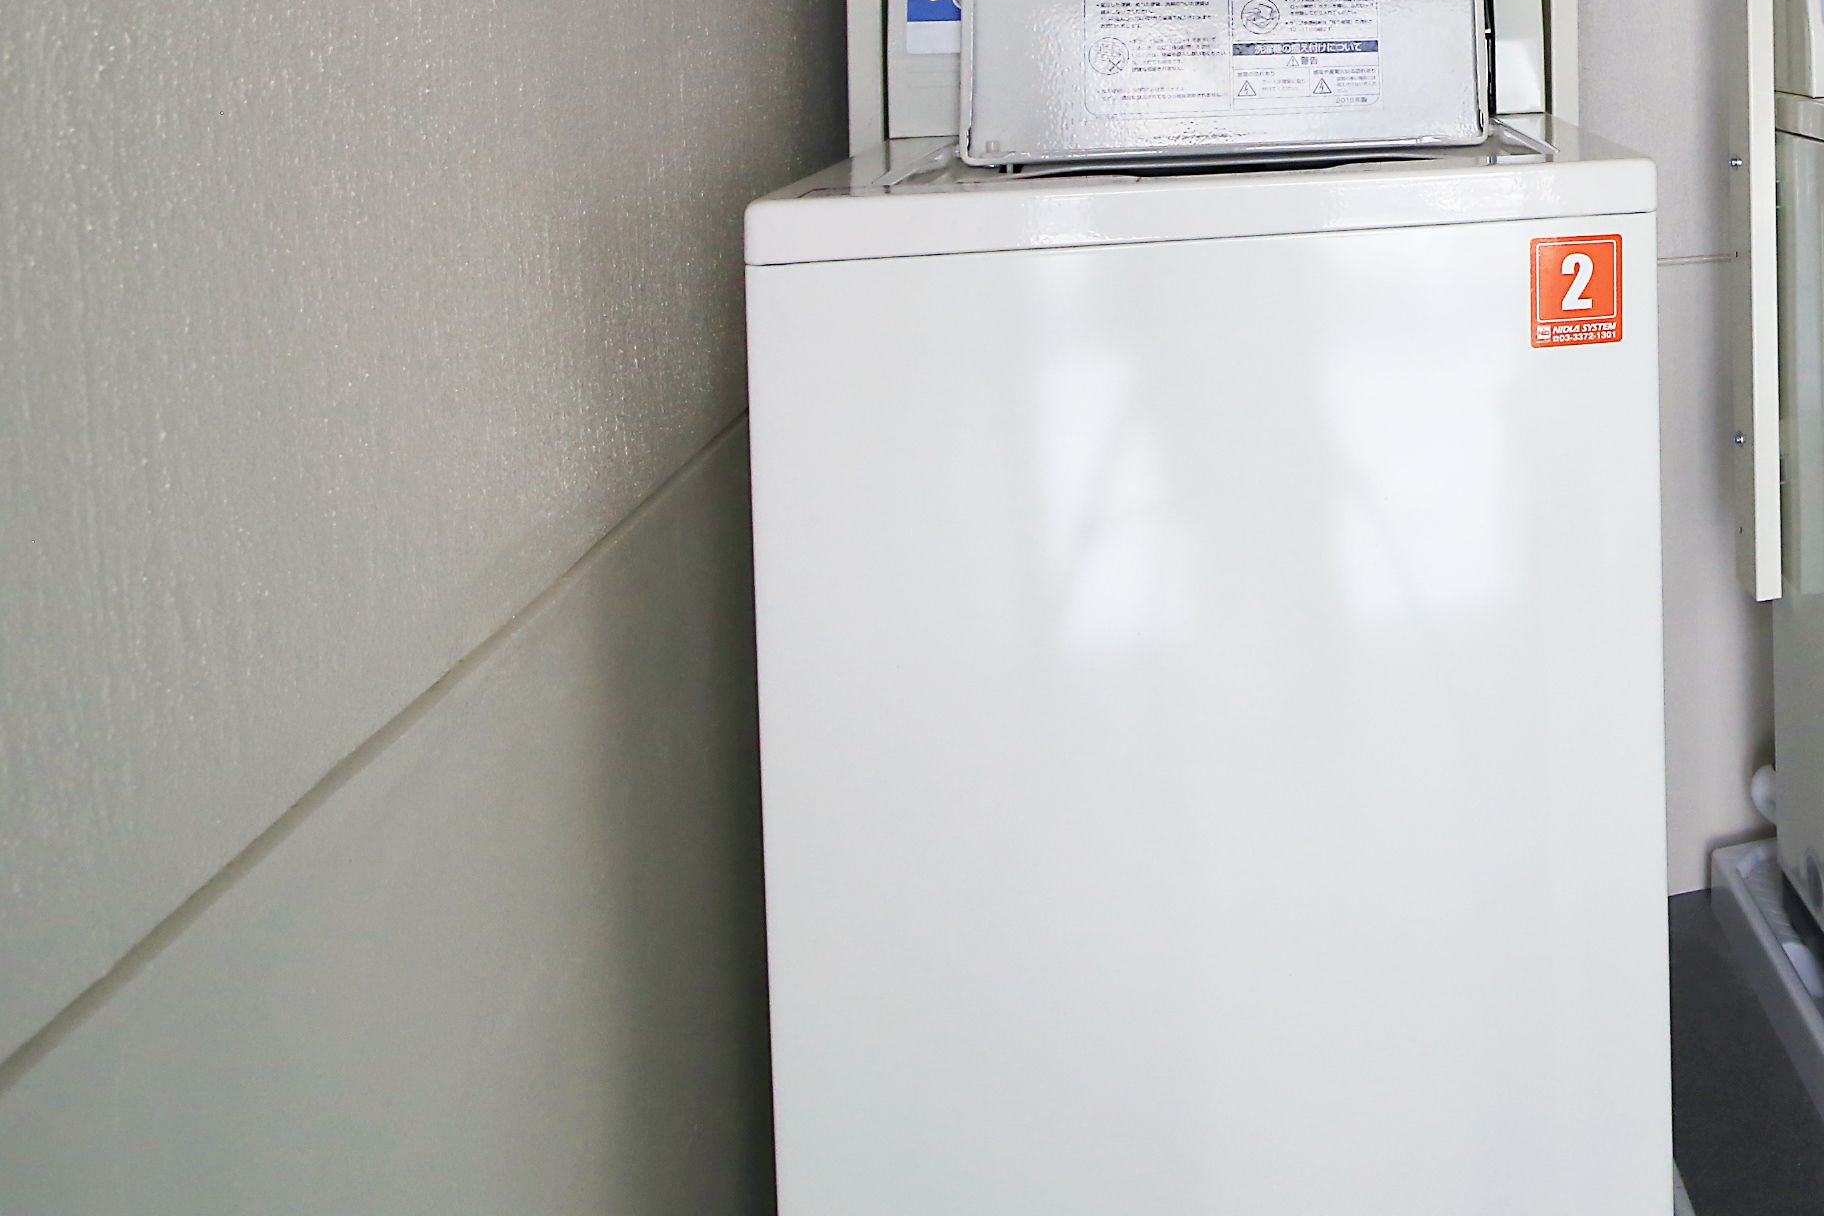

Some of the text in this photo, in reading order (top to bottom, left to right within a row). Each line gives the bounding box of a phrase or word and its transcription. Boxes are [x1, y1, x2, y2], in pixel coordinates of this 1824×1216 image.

[1562, 253, 1594, 310] 2
[1582, 323, 1616, 332] SYSTEM
[1560, 331, 1616, 342] 03-3372-1301
